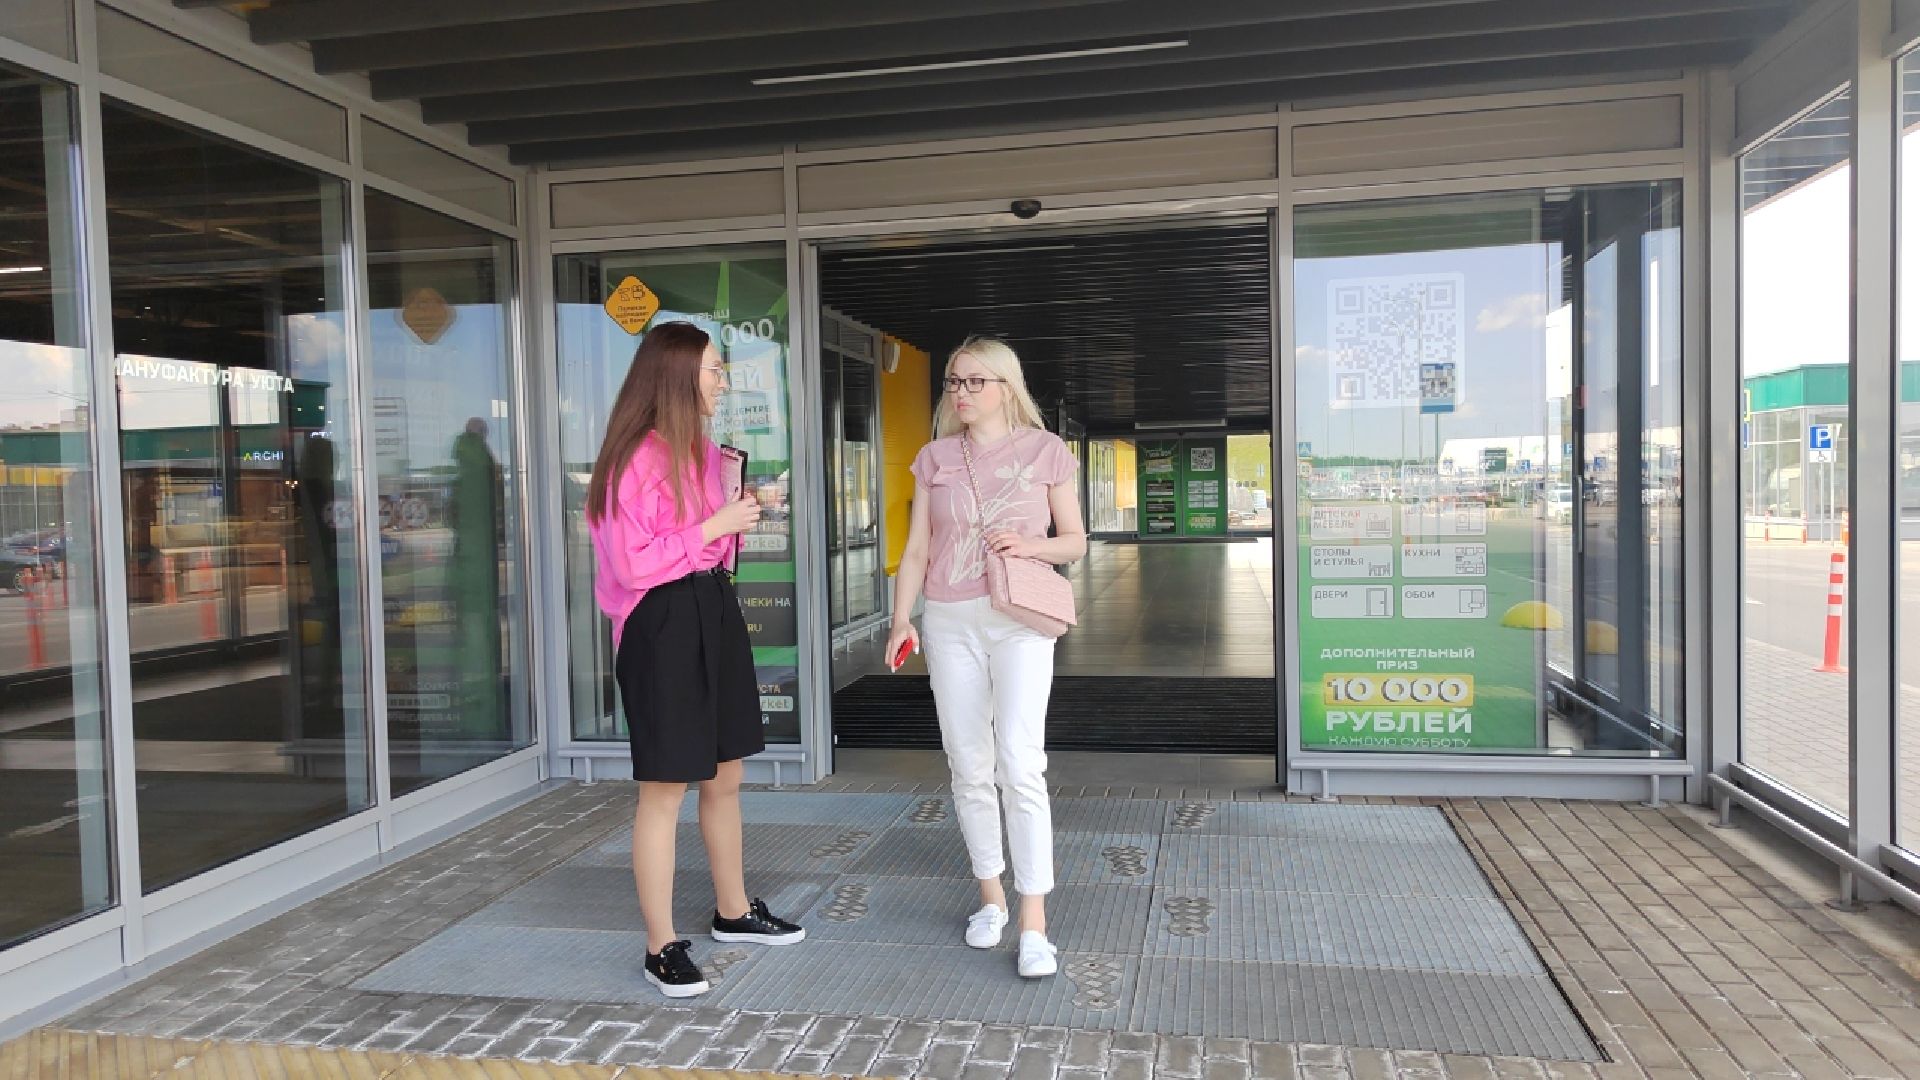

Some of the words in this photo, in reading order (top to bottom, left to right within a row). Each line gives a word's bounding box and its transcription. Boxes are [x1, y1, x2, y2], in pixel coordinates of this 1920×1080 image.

[1816, 428, 1830, 448] P
[1314, 548, 1351, 557] СТОЛЫ
[1404, 548, 1441, 558] КУХНИ
[1314, 558, 1321, 566] И
[1323, 557, 1364, 566] СТУЛЬЯ
[1314, 590, 1348, 599] ДВЕРИ
[1405, 590, 1435, 599] ОБОИ
[743, 597, 773, 607] ЧЕКИ
[775, 597, 791, 607] НА
[746, 623, 763, 632] RU
[1320, 647, 1475, 660] ДОПОЛНИТЕЛЬНЫЙ
[1376, 660, 1418, 670] ПРИЗ
[1327, 677, 1375, 702] 10
[1381, 676, 1469, 703] 000
[1326, 707, 1472, 734] РУБЛЕЙ
[1328, 735, 1397, 747] КАЖДУЮ
[1400, 736, 1471, 749] СУББОТУ
